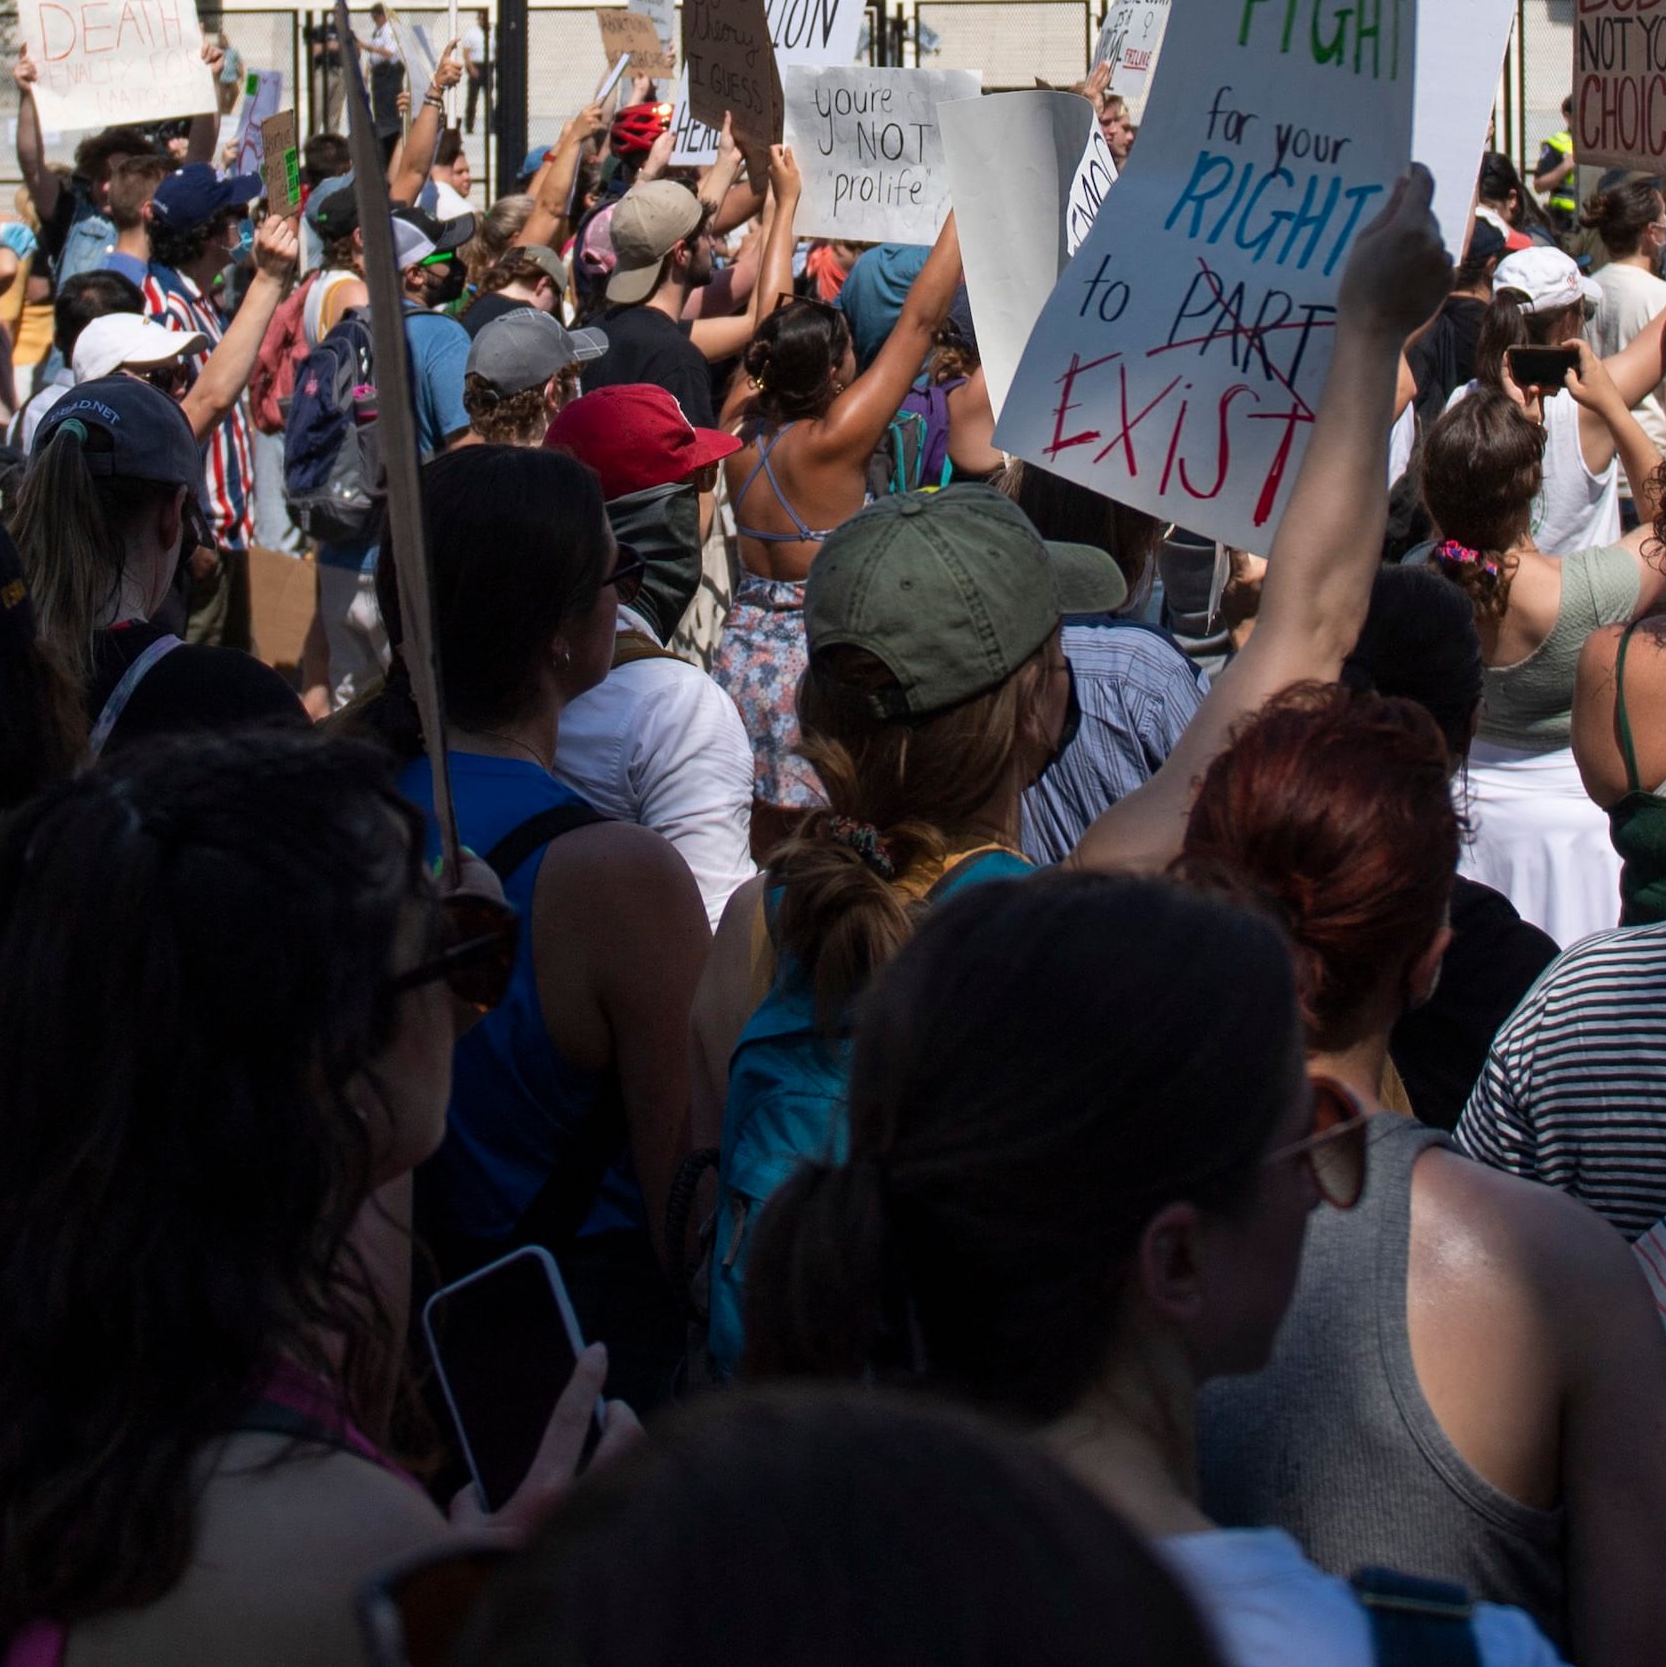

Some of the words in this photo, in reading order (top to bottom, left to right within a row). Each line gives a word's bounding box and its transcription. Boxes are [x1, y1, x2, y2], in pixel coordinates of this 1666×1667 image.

[1579, 16, 1634, 73] NOT
[690, 52, 704, 87] I
[709, 62, 764, 115] GUESS
[856, 120, 934, 164] NOT
[1207, 86, 1259, 145] for
[1275, 123, 1351, 178] your
[1164, 149, 1385, 276] RIGHT
[1080, 254, 1131, 322] to
[1168, 270, 1337, 390] PART
